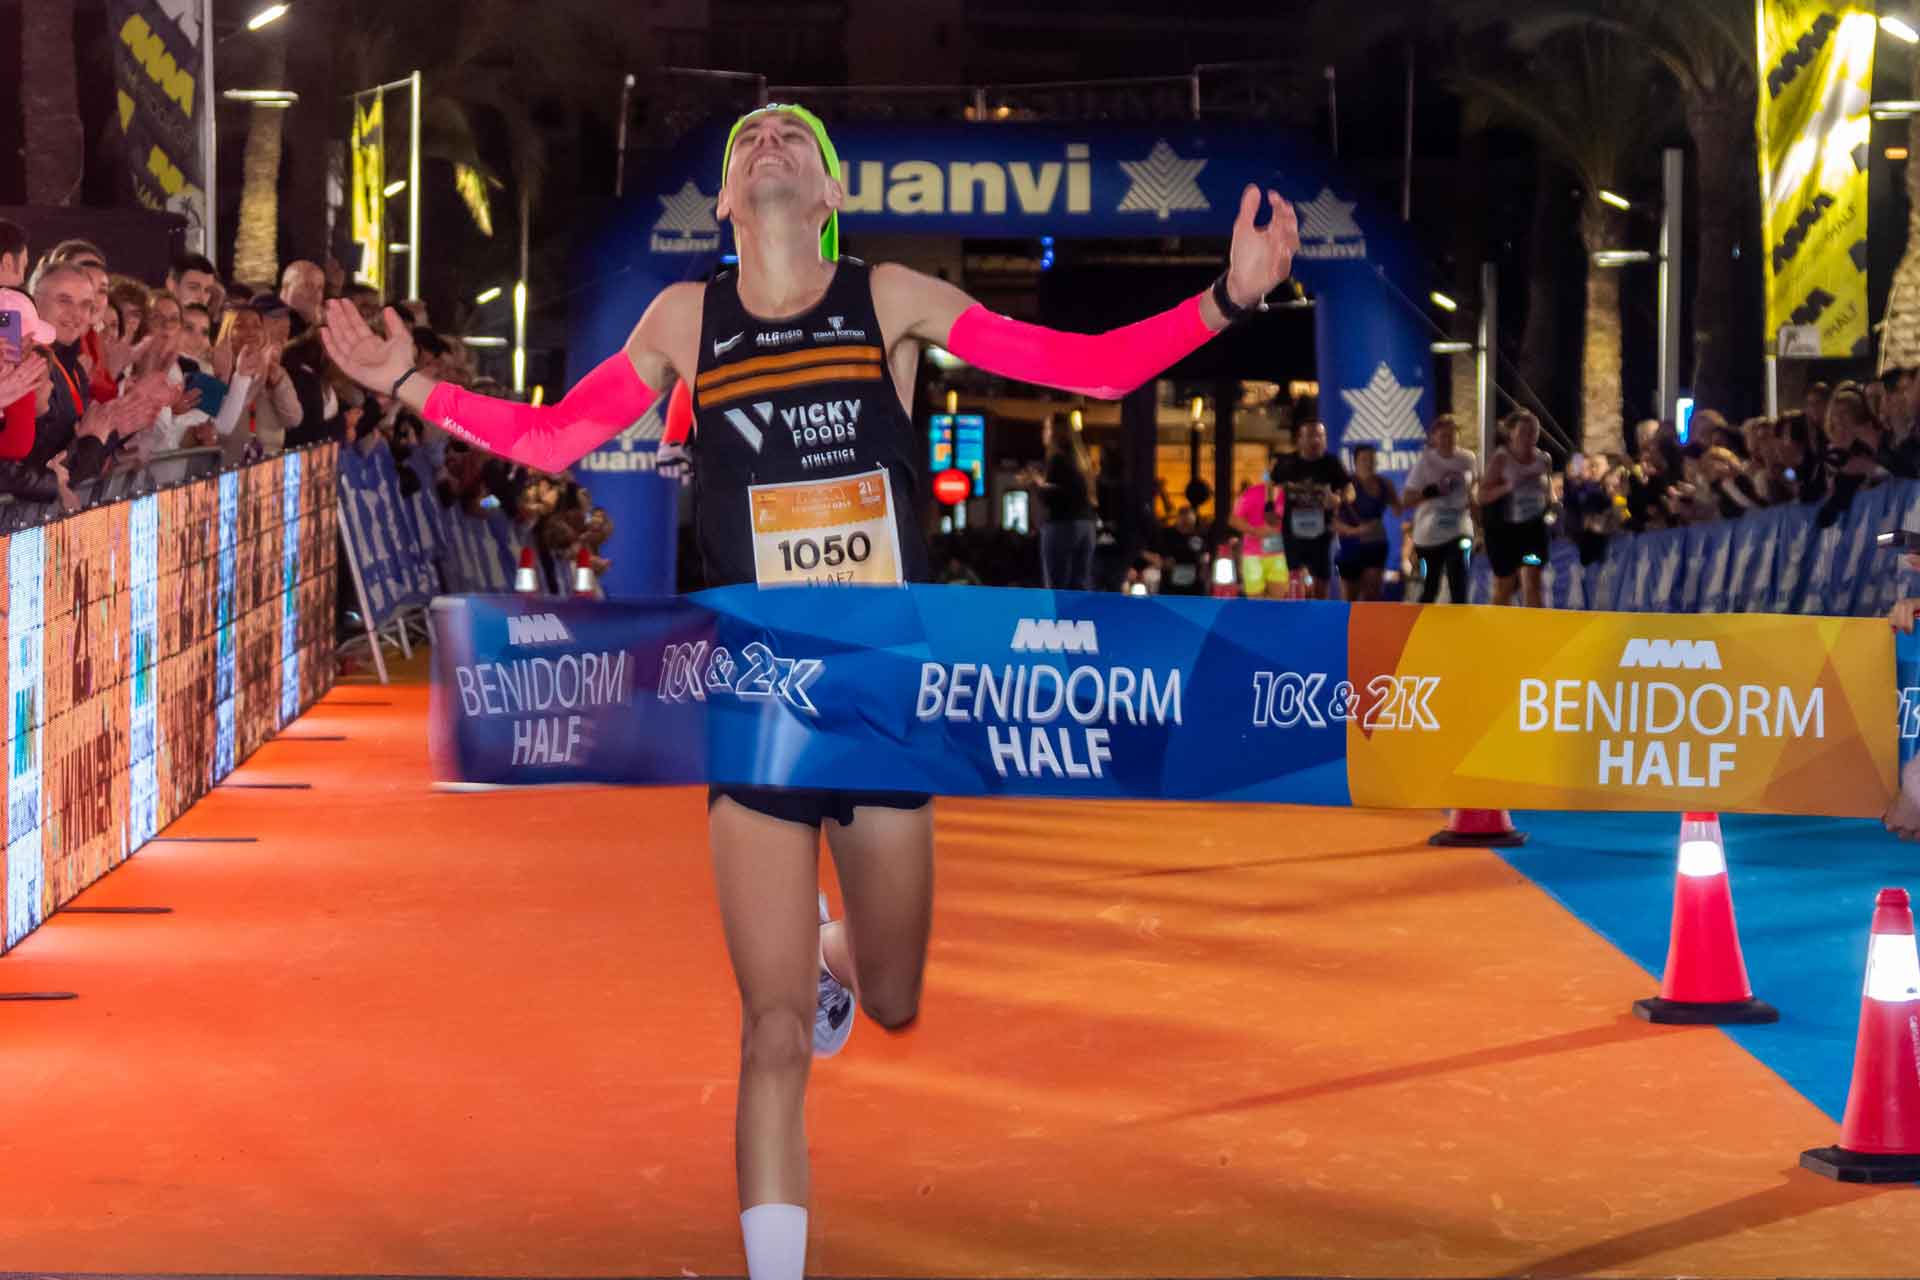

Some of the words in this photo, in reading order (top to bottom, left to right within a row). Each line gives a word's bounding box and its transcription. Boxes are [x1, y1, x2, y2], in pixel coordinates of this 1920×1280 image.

[838, 143, 1091, 214] uanvi
[780, 399, 861, 430] VICKY
[792, 422, 856, 448] FOODS
[801, 448, 855, 469] ATHLETICS
[778, 531, 871, 571] 1050
[456, 650, 627, 716] BENIDORM
[657, 640, 709, 702] 10K
[705, 647, 736, 692] &
[915, 662, 1183, 726] BENIDORM
[1253, 671, 1328, 728] 10K
[1328, 680, 1361, 720] &
[1363, 674, 1441, 730] 21K
[1518, 678, 1825, 738] BENIDORM
[511, 715, 582, 766] HALF
[987, 725, 1112, 778] HALF
[1598, 739, 1737, 787] HALF
